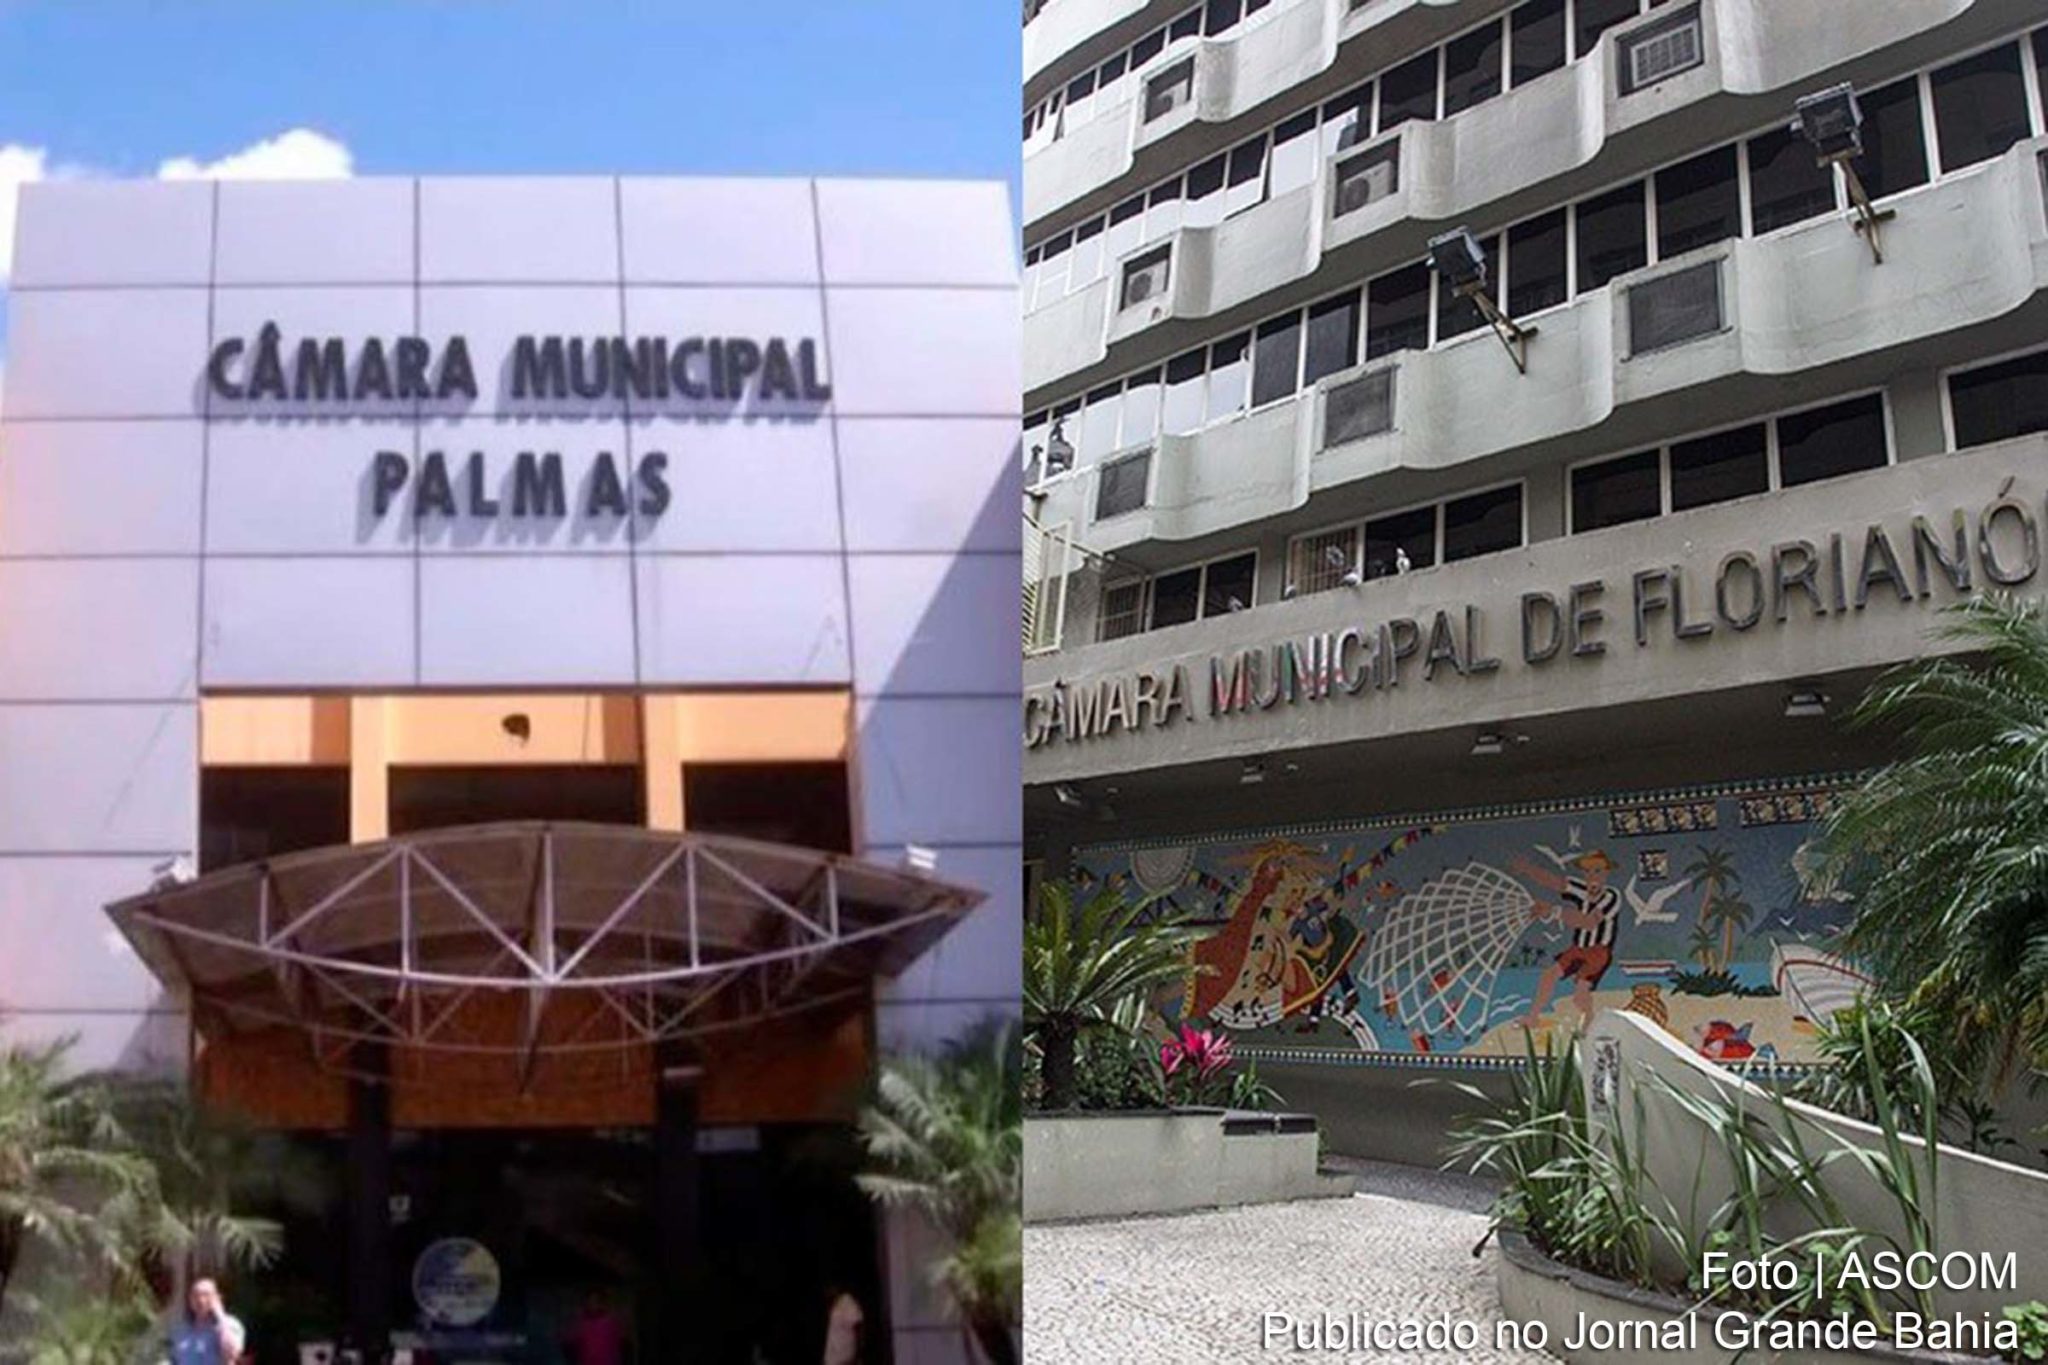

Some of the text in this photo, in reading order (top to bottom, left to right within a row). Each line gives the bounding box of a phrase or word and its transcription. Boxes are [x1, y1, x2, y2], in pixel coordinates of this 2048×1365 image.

[207, 320, 832, 401] CÂMARA MUNICIPAL
[372, 450, 672, 517] PALMAS
[1023, 475, 2048, 749] CÂMARA MUNICIPAL DE FLORIANÓ
